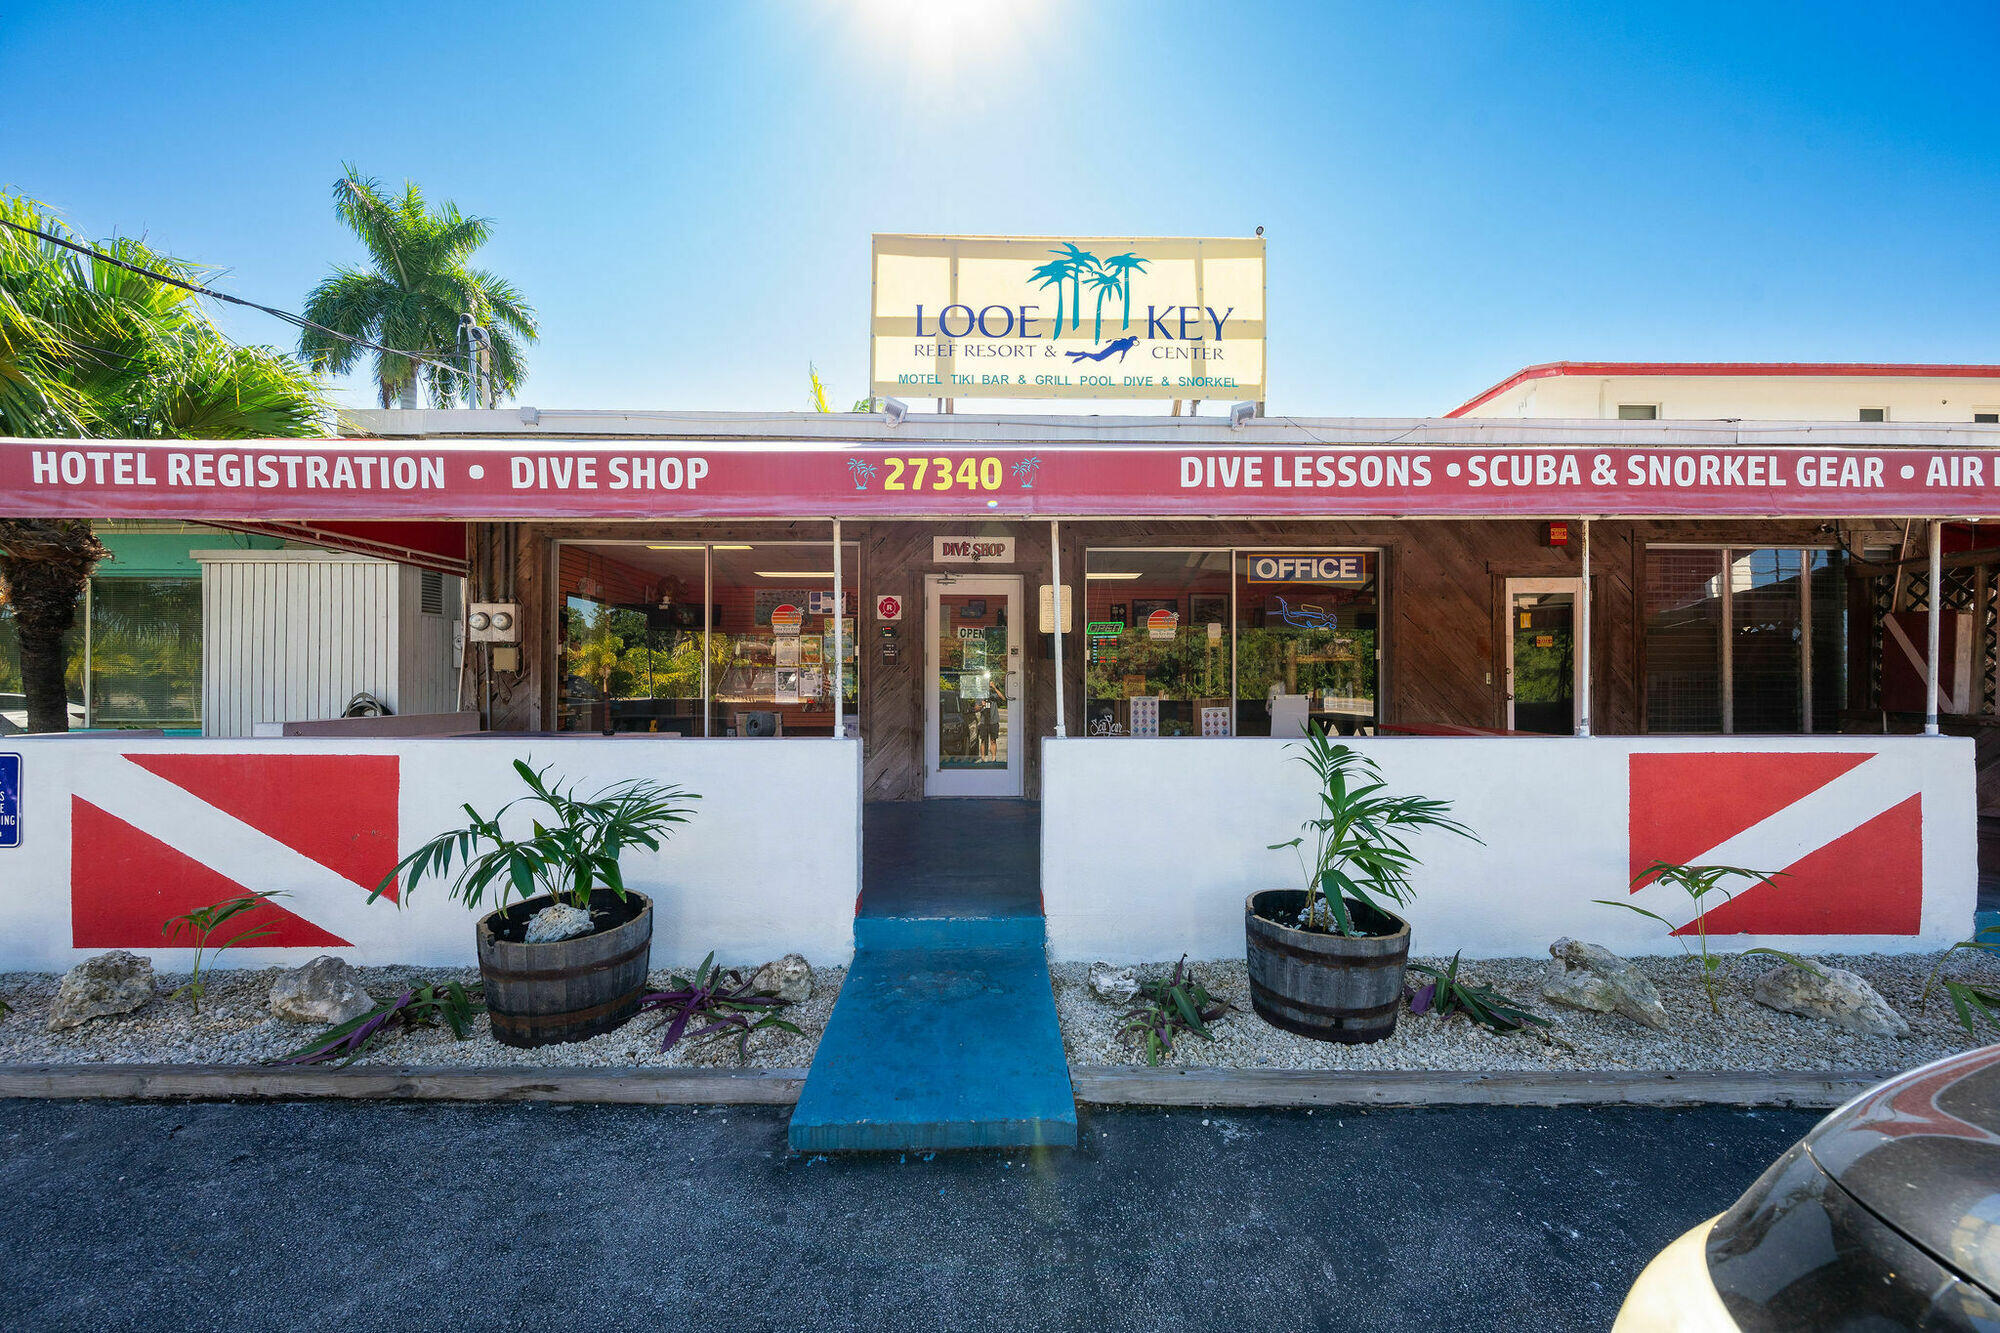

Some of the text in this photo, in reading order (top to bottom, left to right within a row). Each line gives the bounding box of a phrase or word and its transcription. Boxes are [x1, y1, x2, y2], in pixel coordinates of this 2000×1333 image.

[916, 304, 1234, 341] LOOE KEY
[914, 344, 1224, 360] REEF RESORT & CENTER
[898, 374, 1239, 388] MOTEL TIKI BAR & GRILL POOL DIVE & SNORKEL
[32, 451, 709, 490] HOTEL REGISTRATION DIVE SHOP
[884, 457, 1003, 491] 27340
[1180, 456, 1263, 488] DIVE
[1274, 456, 1432, 488] LESSONS
[1467, 455, 1582, 487] SCUBA
[1591, 454, 1618, 486] &
[1628, 455, 1787, 487] SNORKEL
[1797, 456, 1885, 488] GEAR
[1926, 456, 1985, 487] AIR
[943, 541, 1006, 557] DIVE SHOP
[1256, 558, 1358, 579] OFFICE
[960, 628, 985, 639] OPEN
[1089, 624, 1120, 632] OPEN
